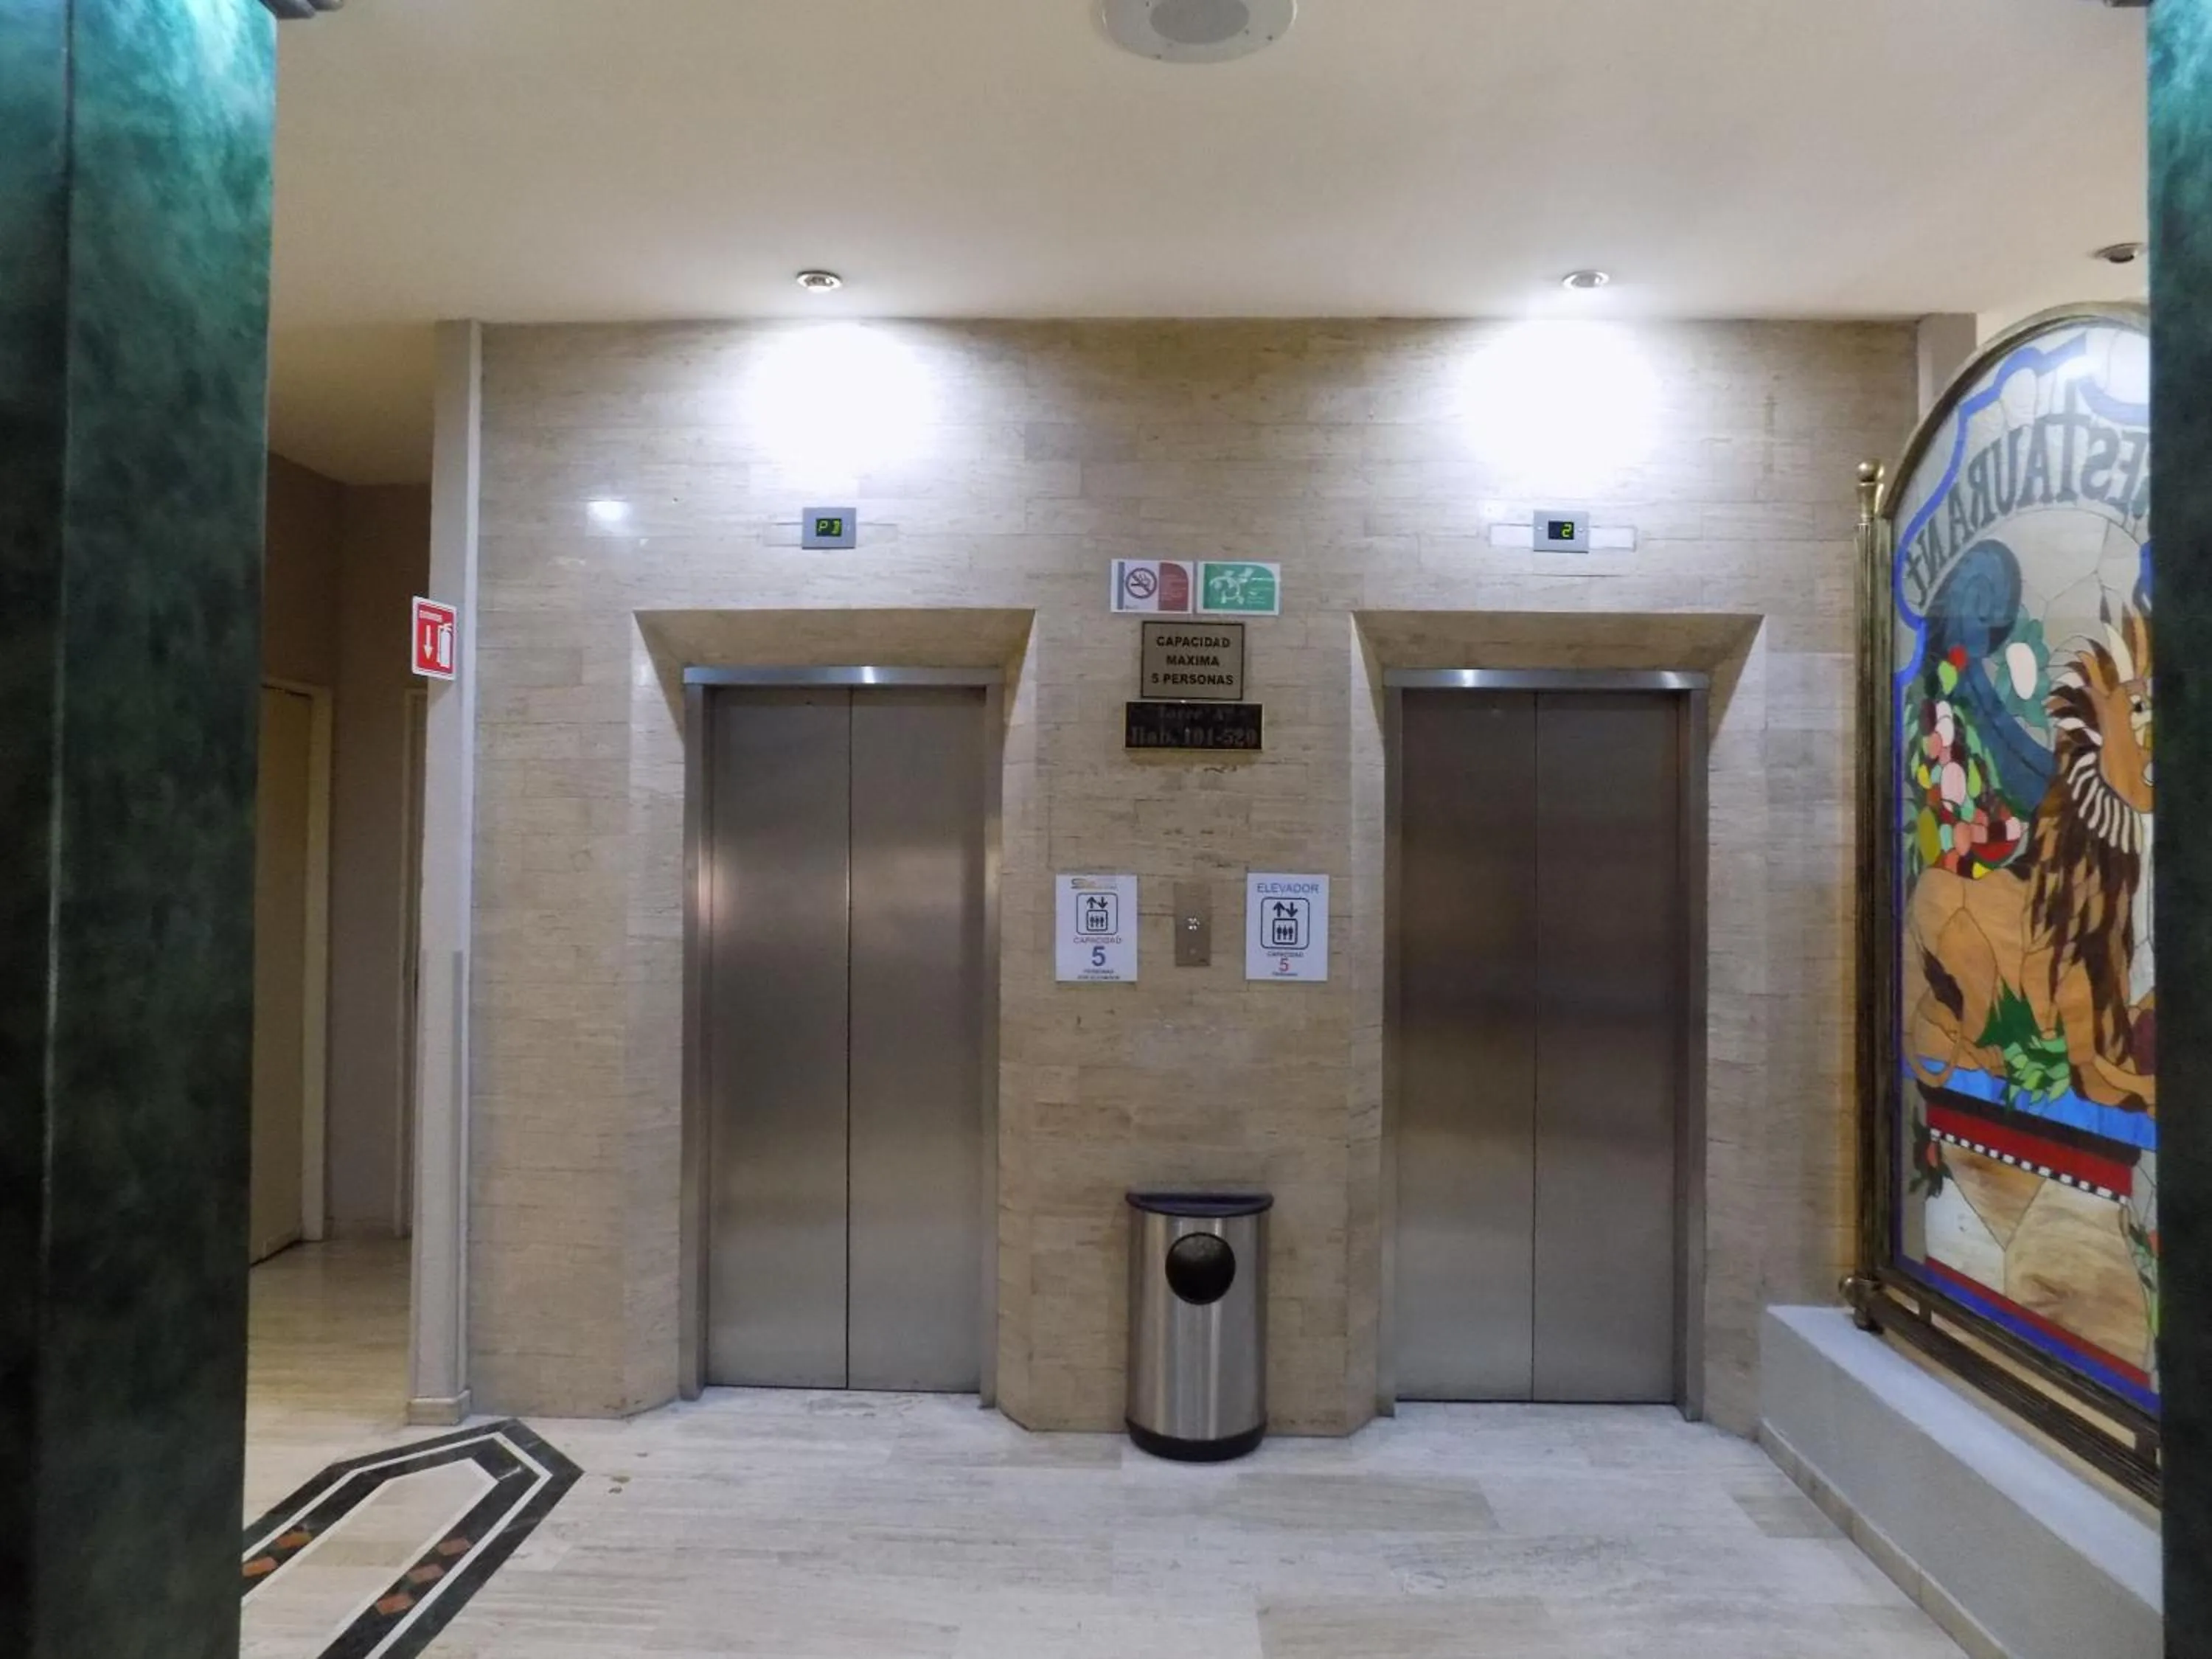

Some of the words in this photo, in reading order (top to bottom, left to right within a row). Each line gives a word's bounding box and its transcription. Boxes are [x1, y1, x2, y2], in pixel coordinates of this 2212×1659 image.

[1561, 523, 1573, 538] 2
[1155, 636, 1231, 648] CAPACIDAD
[1166, 655, 1220, 667] MAXIMA
[1151, 672, 1160, 684] 5
[1163, 673, 1234, 686] PERSONAS
[1256, 882, 1320, 894] ELEVADOR
[1073, 935, 1122, 945] CAPACIDAD
[1091, 945, 1106, 967] 5
[1279, 958, 1290, 972] 5
